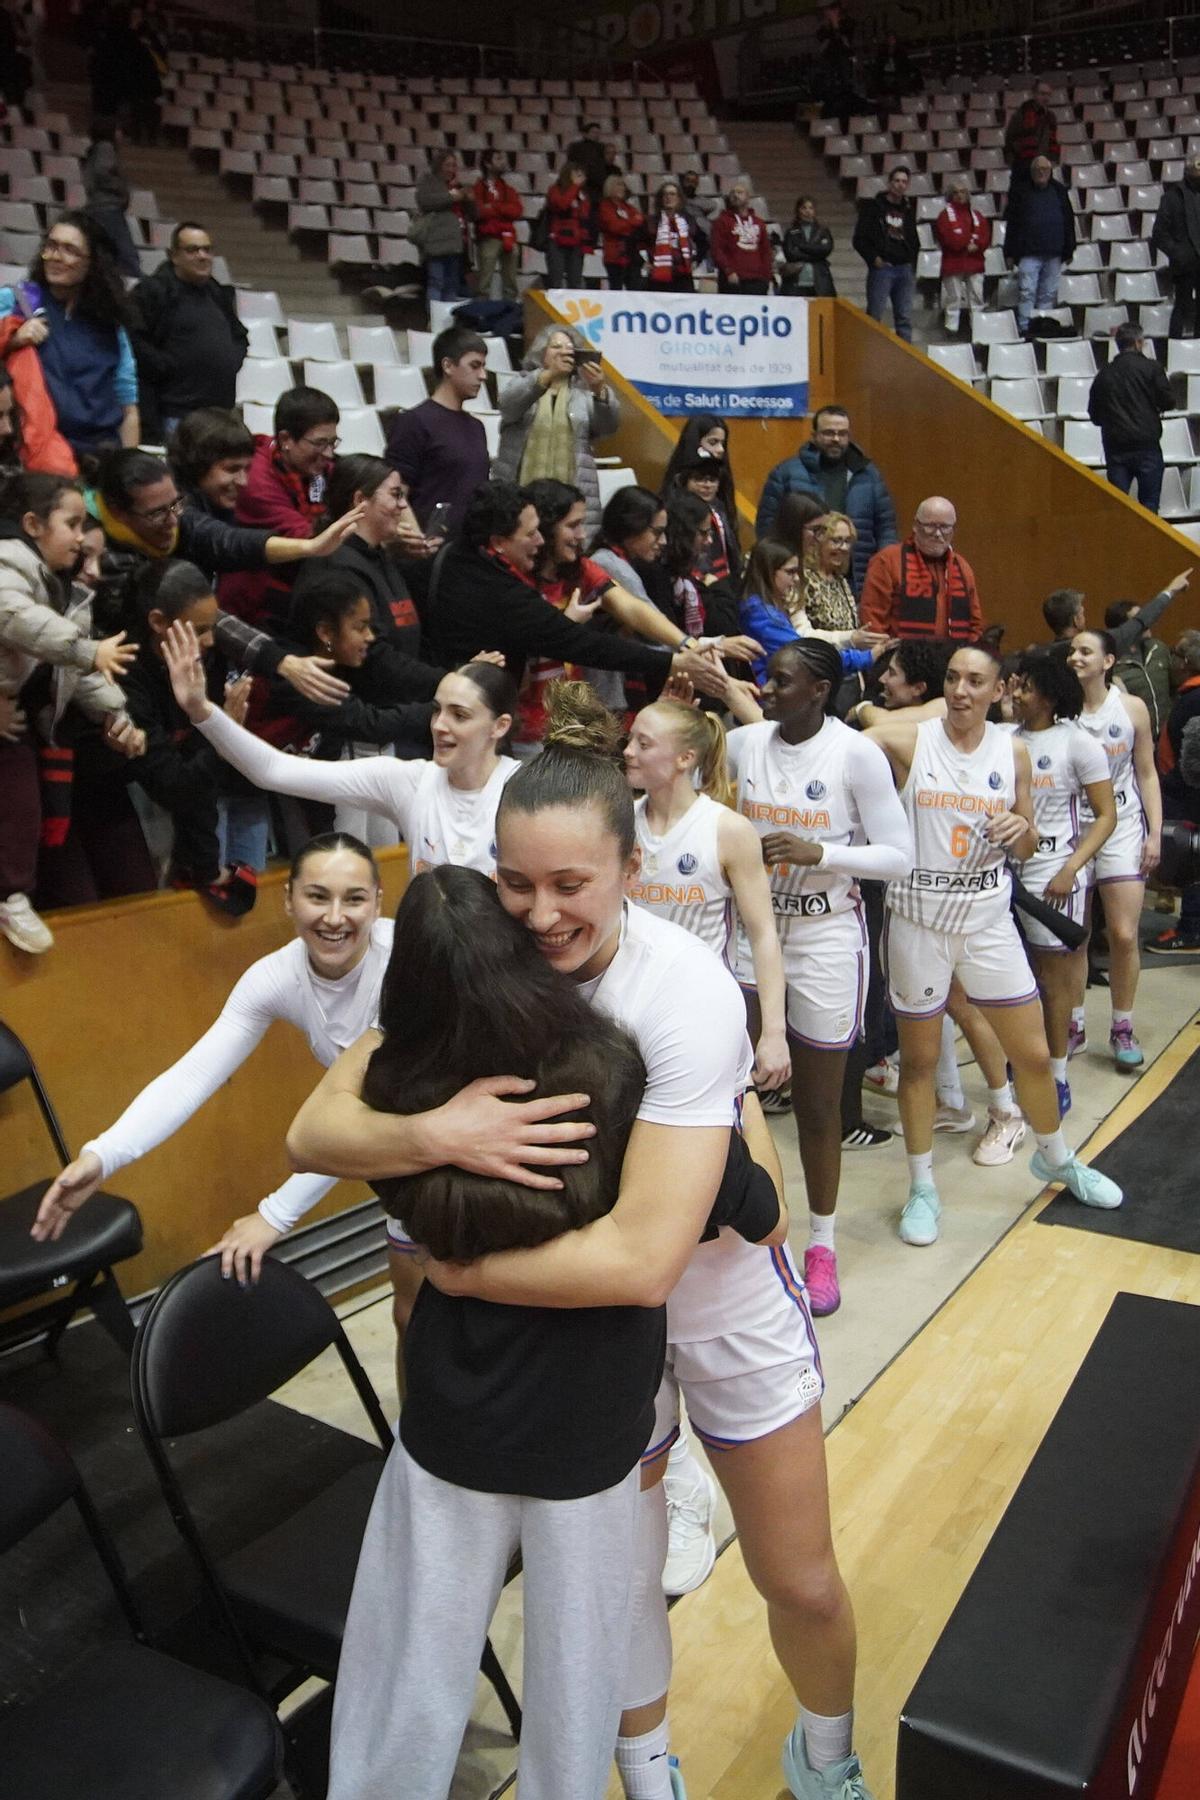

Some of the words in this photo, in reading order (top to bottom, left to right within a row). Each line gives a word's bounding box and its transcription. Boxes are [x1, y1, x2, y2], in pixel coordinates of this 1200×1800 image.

[612, 305, 792, 345] montepio
[660, 340, 733, 357] GIRONA
[663, 393, 681, 407] de
[684, 393, 719, 408] Salut
[729, 394, 794, 409] Decessos
[917, 790, 1007, 815] GIRONA
[951, 825, 970, 858] 6
[918, 873, 981, 889] SPAR
